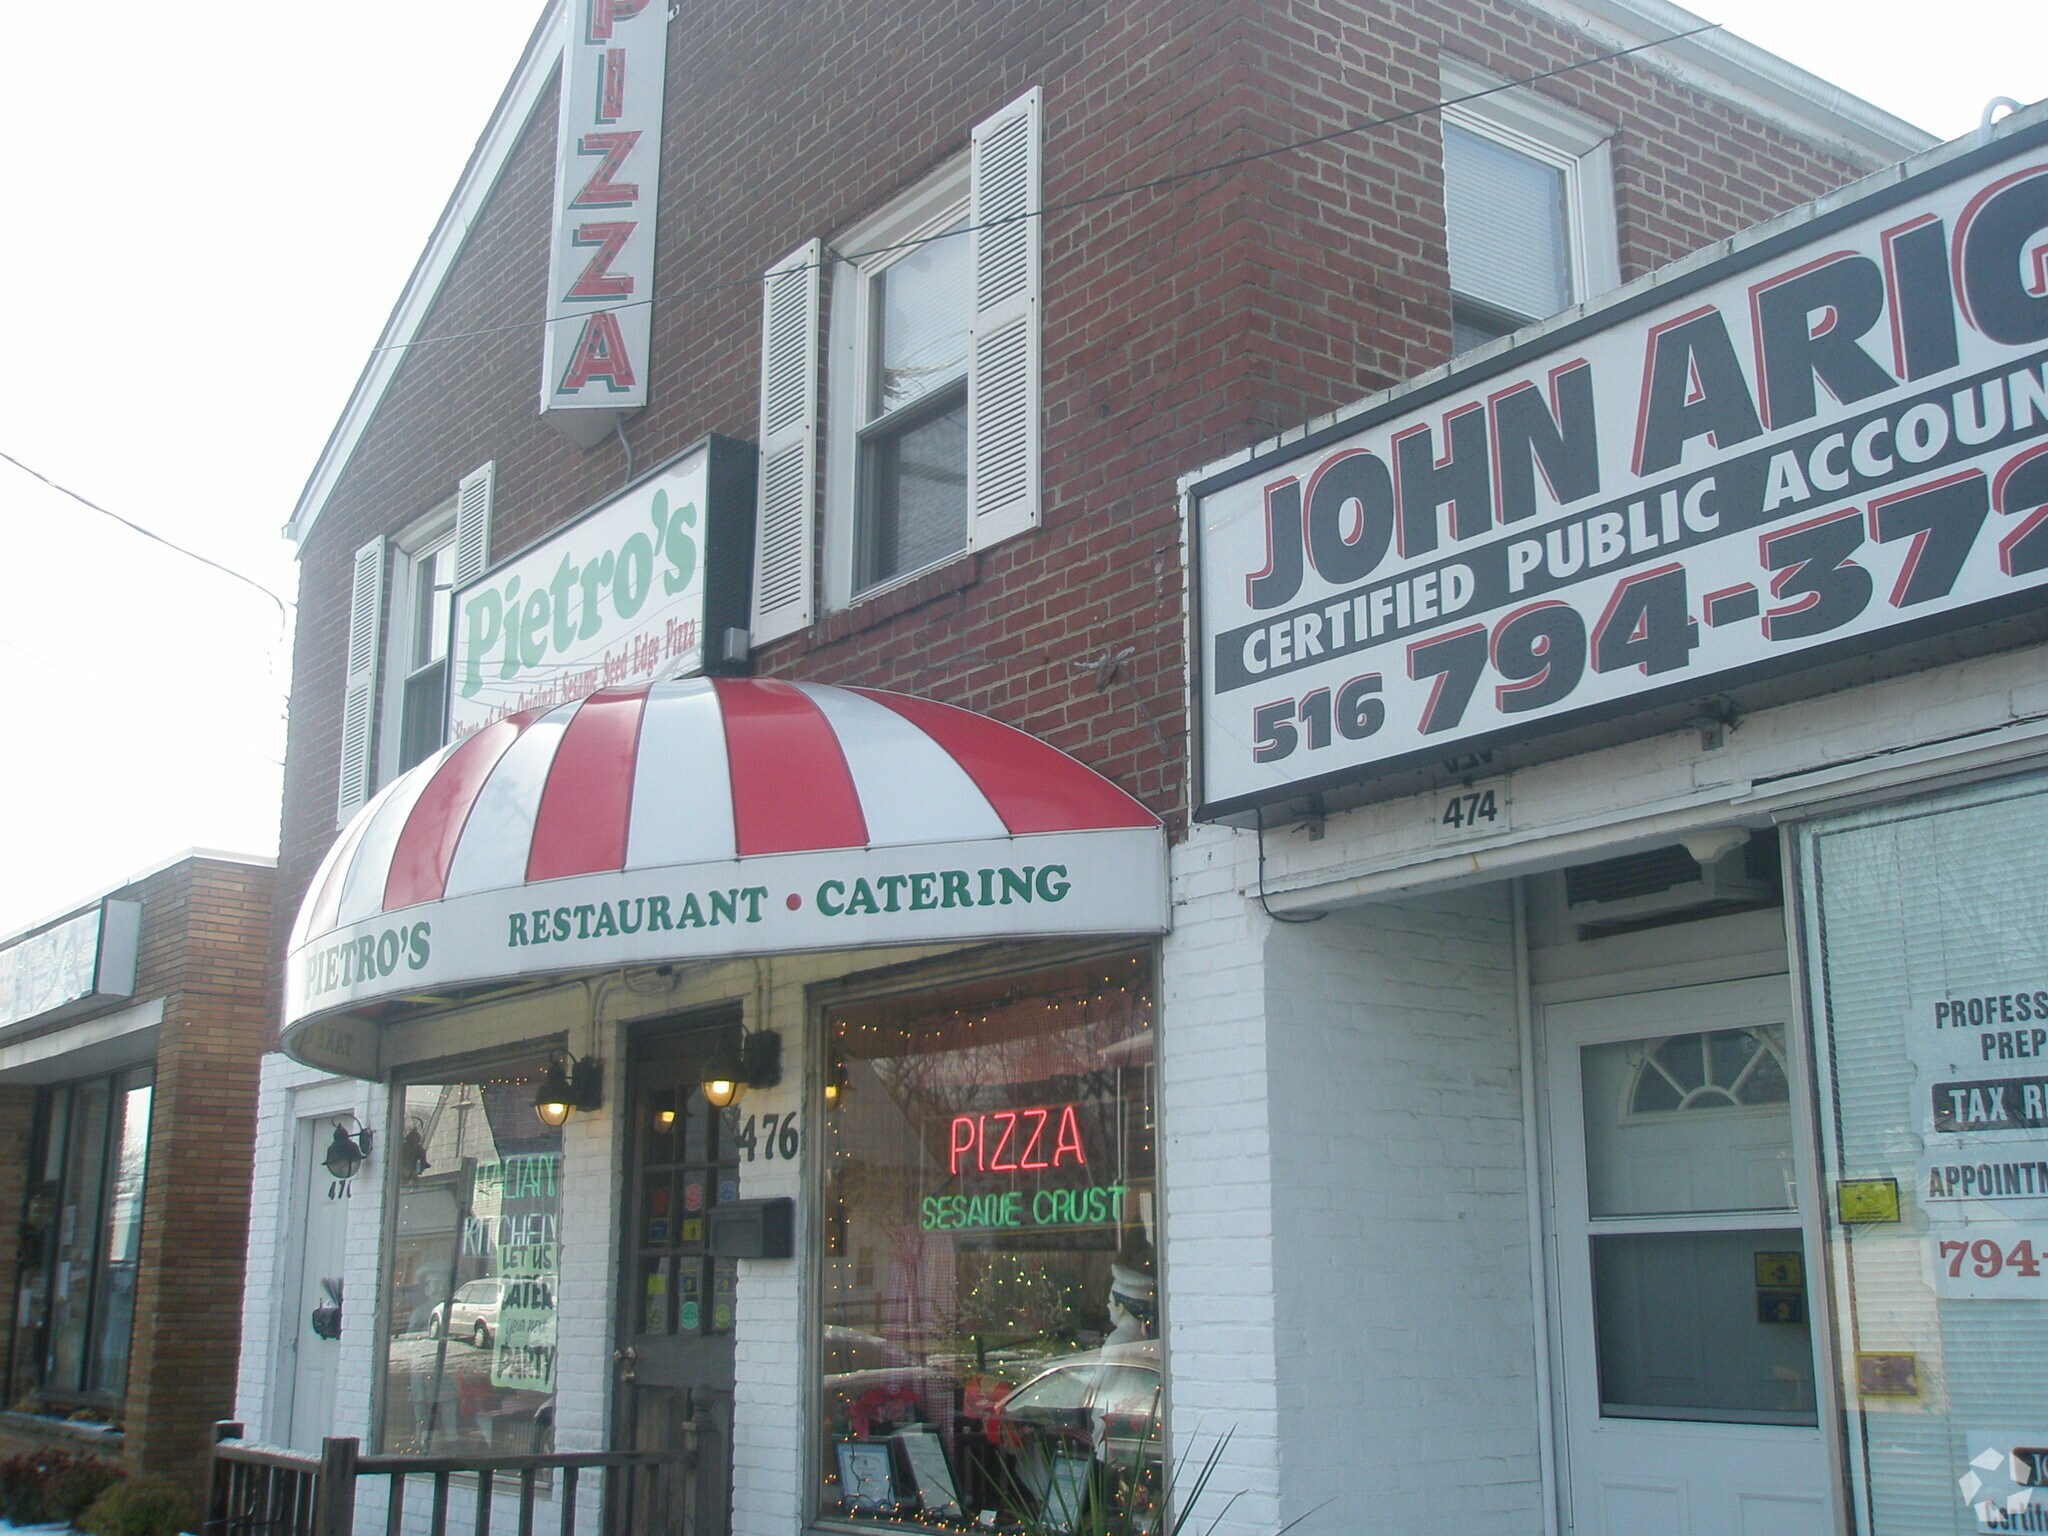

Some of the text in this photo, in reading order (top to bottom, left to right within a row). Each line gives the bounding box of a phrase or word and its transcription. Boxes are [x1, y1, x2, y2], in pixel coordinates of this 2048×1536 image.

[556, 0, 650, 394] PIZZA
[1245, 163, 2048, 611] JOHN ARIG
[1243, 362, 2048, 674] CERTIFIED PUBLIC ACCOUN
[462, 488, 697, 698] Pietro's
[562, 666, 598, 702] Sesame
[603, 641, 628, 687] Seed
[632, 632, 660, 677] Edge
[664, 616, 696, 659] Pizza
[1253, 671, 1386, 764] 516
[1442, 789, 1497, 829] 474
[305, 864, 1071, 1000] PIETRO'S RESTAURANT CATERING
[1935, 991, 2048, 1029] PROFESS
[1981, 1028, 2047, 1061] PREP
[1949, 1084, 2048, 1124] TAX R
[736, 1111, 799, 1162] 476
[950, 1105, 1084, 1175] PIZZA
[463, 1213, 557, 1255] KITCHEN
[922, 1185, 1129, 1231] SESAME CRUST
[503, 1244, 553, 1270] LET US
